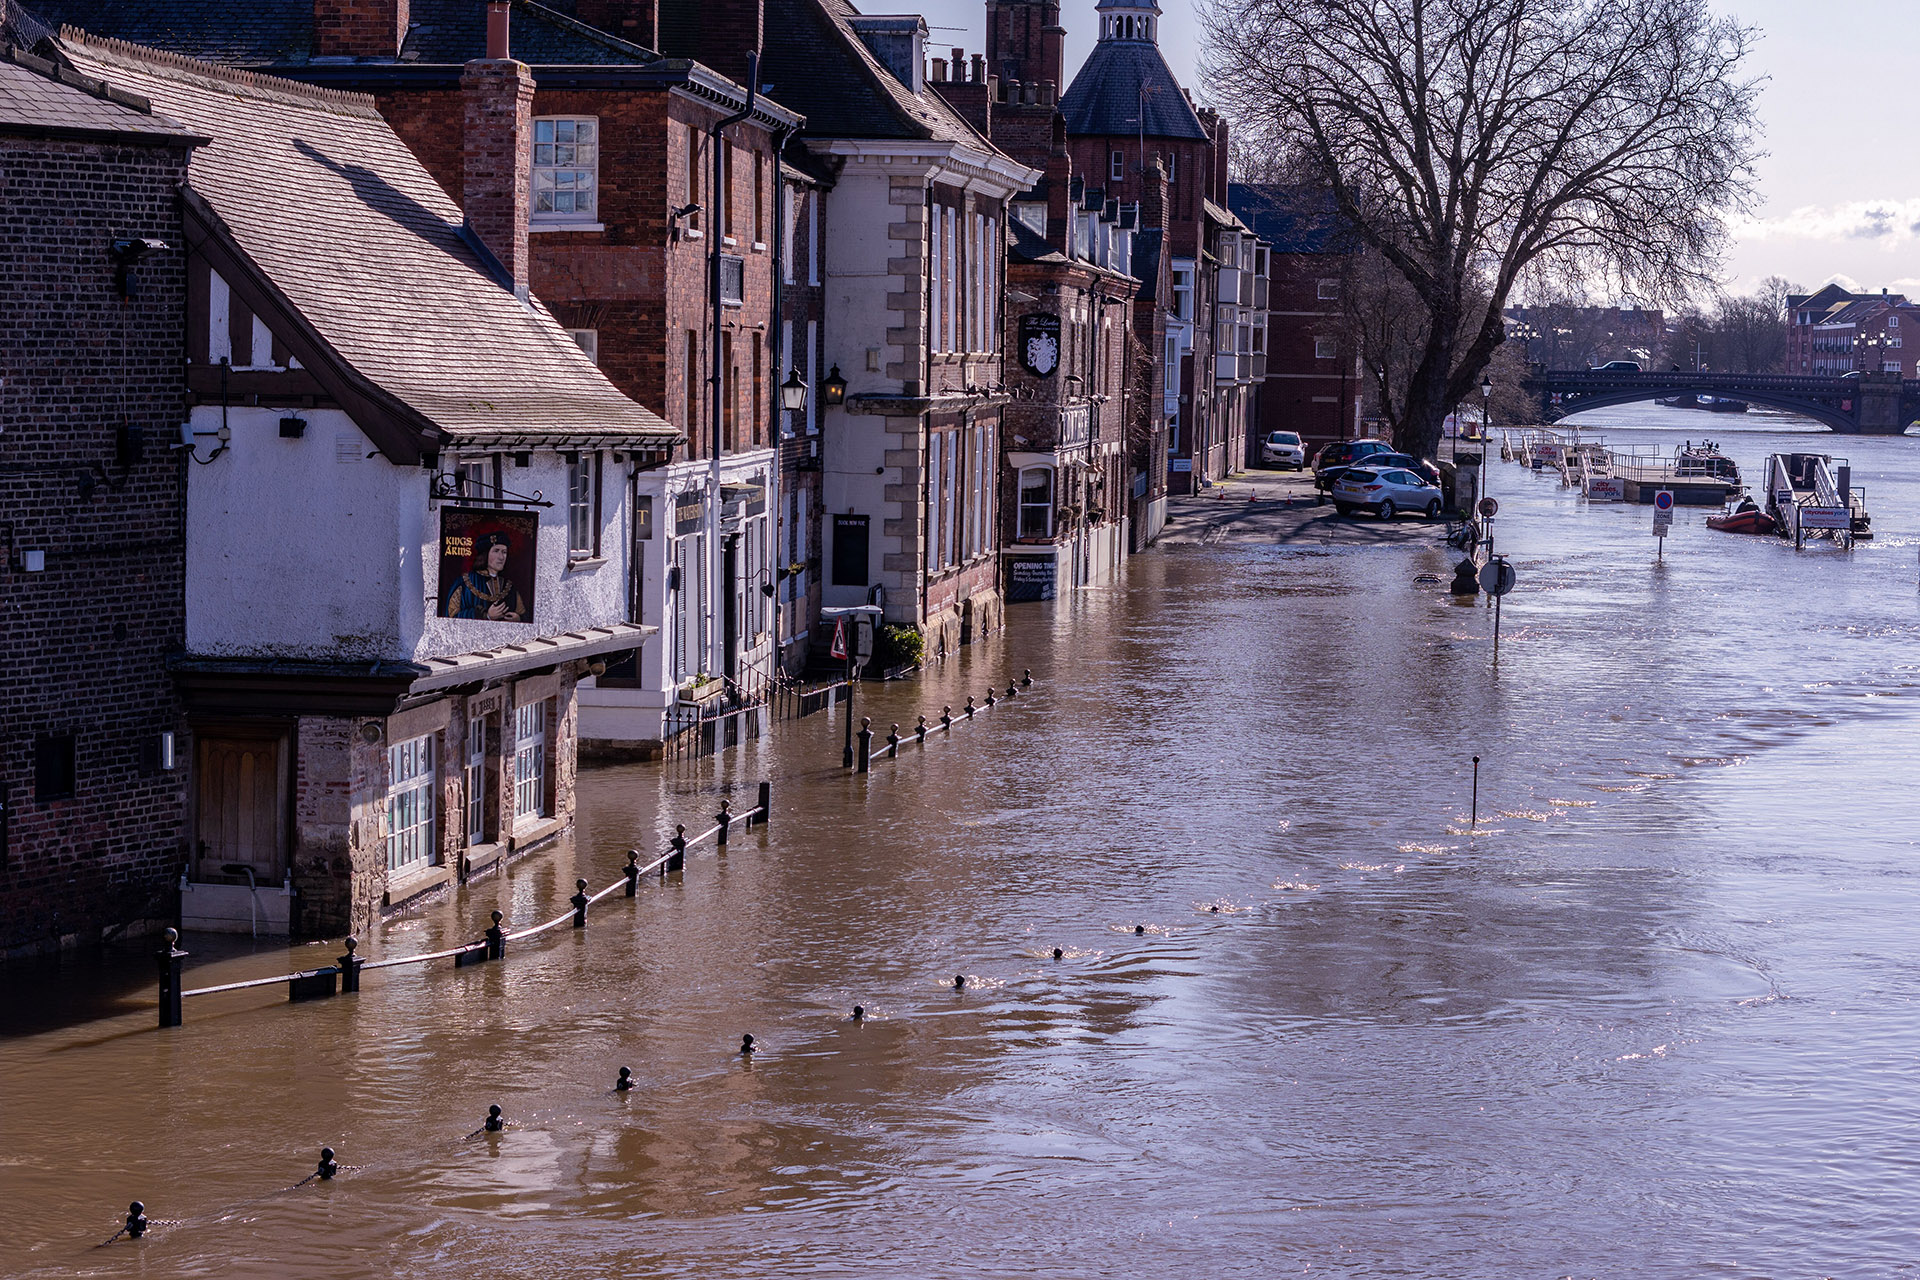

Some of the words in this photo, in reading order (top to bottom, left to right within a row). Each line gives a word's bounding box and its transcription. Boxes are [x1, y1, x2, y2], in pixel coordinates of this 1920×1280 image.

[445, 536, 473, 546] KINGS
[444, 545, 472, 557] ARMS
[1013, 562, 1043, 570] OPENING
